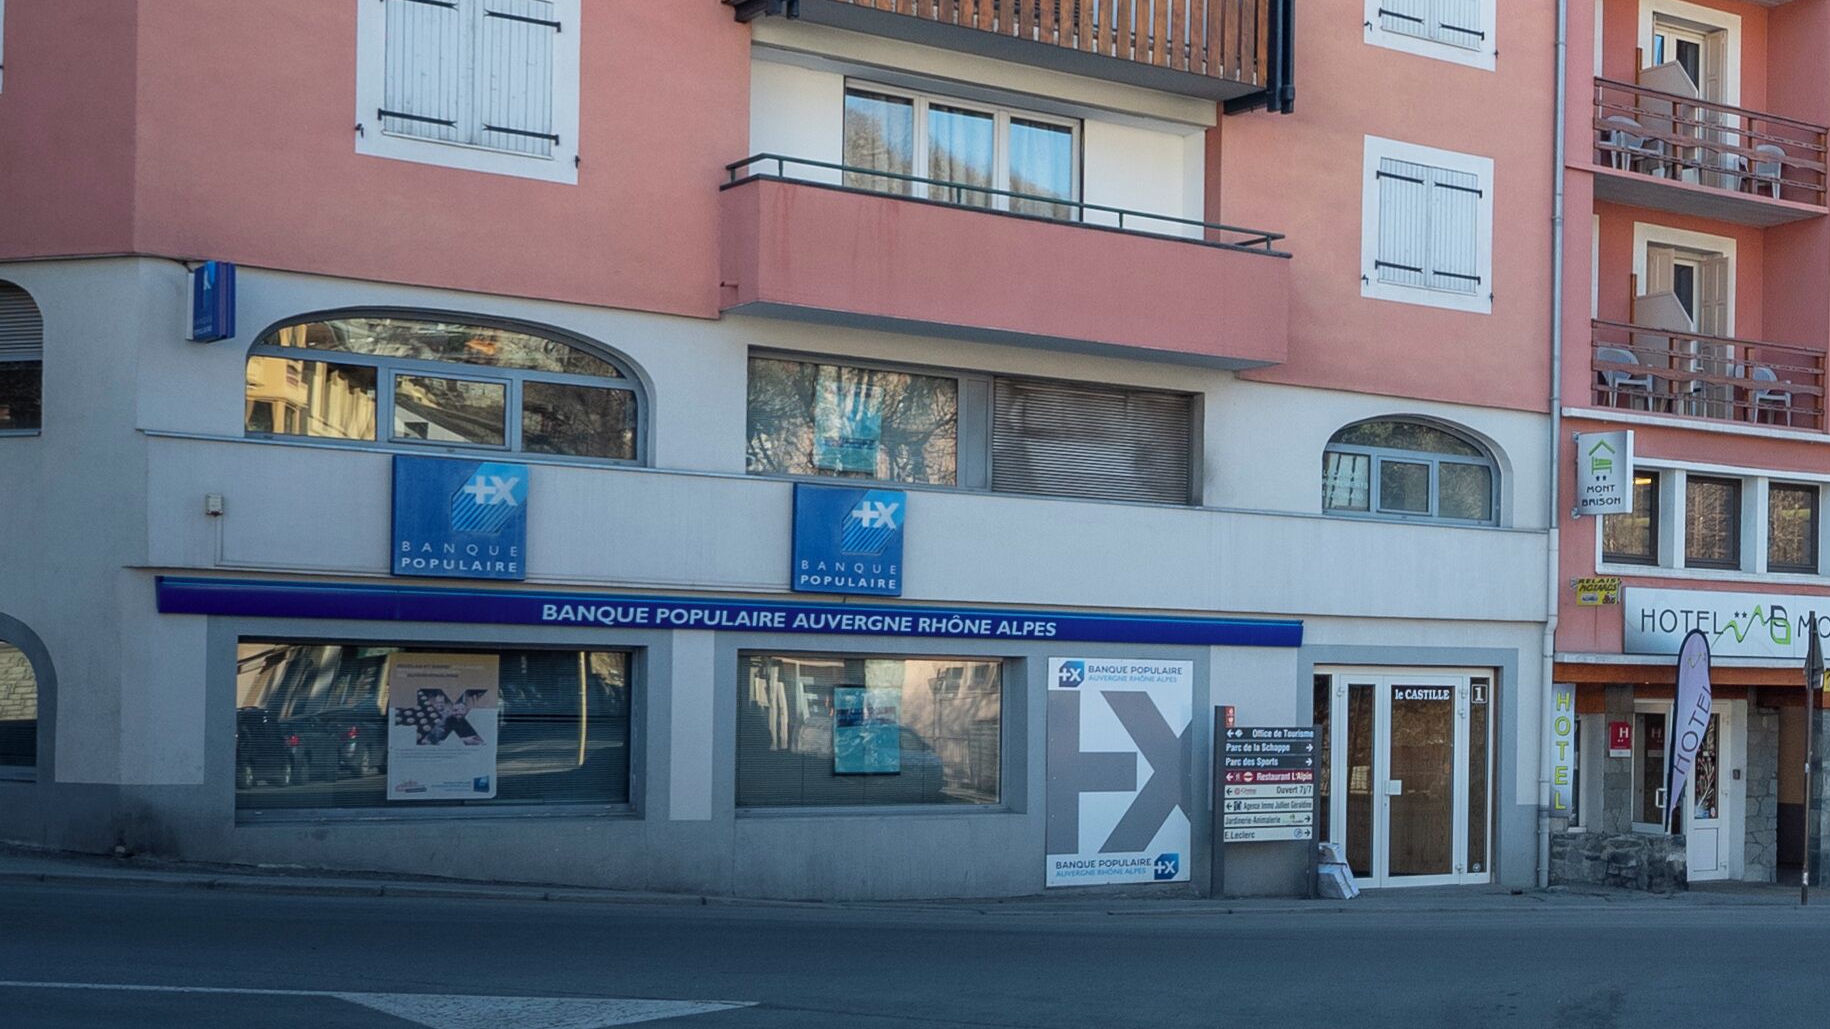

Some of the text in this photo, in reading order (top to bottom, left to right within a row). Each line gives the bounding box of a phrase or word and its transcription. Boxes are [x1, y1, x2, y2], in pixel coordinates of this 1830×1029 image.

[1586, 484, 1615, 493] MONT
[1581, 497, 1621, 507] BRISON
[401, 541, 518, 557] BANQUE
[401, 557, 517, 573] POPULAIRE
[801, 560, 897, 575] BANQUE
[800, 575, 897, 589] POPULAIRE
[542, 604, 1057, 637] BANQUE POPULAIRE AUVERGNE RHÔNE ALPES
[1641, 608, 1723, 635] HOTEL
[1088, 665, 1183, 675] BANQUE POPULAIRE
[1088, 674, 1127, 682] AUVERGNE
[1395, 689, 1450, 700] le CASTILLE
[1475, 686, 1484, 702] 1
[1252, 729, 1314, 738] Office de Tourisme
[1620, 727, 1629, 738] H
[1673, 685, 1712, 775] HOTEL
[1225, 743, 1242, 752] Parc
[1243, 743, 1252, 752] de
[1253, 743, 1260, 752] la
[1554, 691, 1571, 810] HOTEL
[1225, 758, 1278, 768] Parc des Sports
[1256, 772, 1290, 781] Restaurant
[1276, 786, 1298, 795] Ouvert
[1056, 858, 1151, 869] BANQUE POPULAIRE
